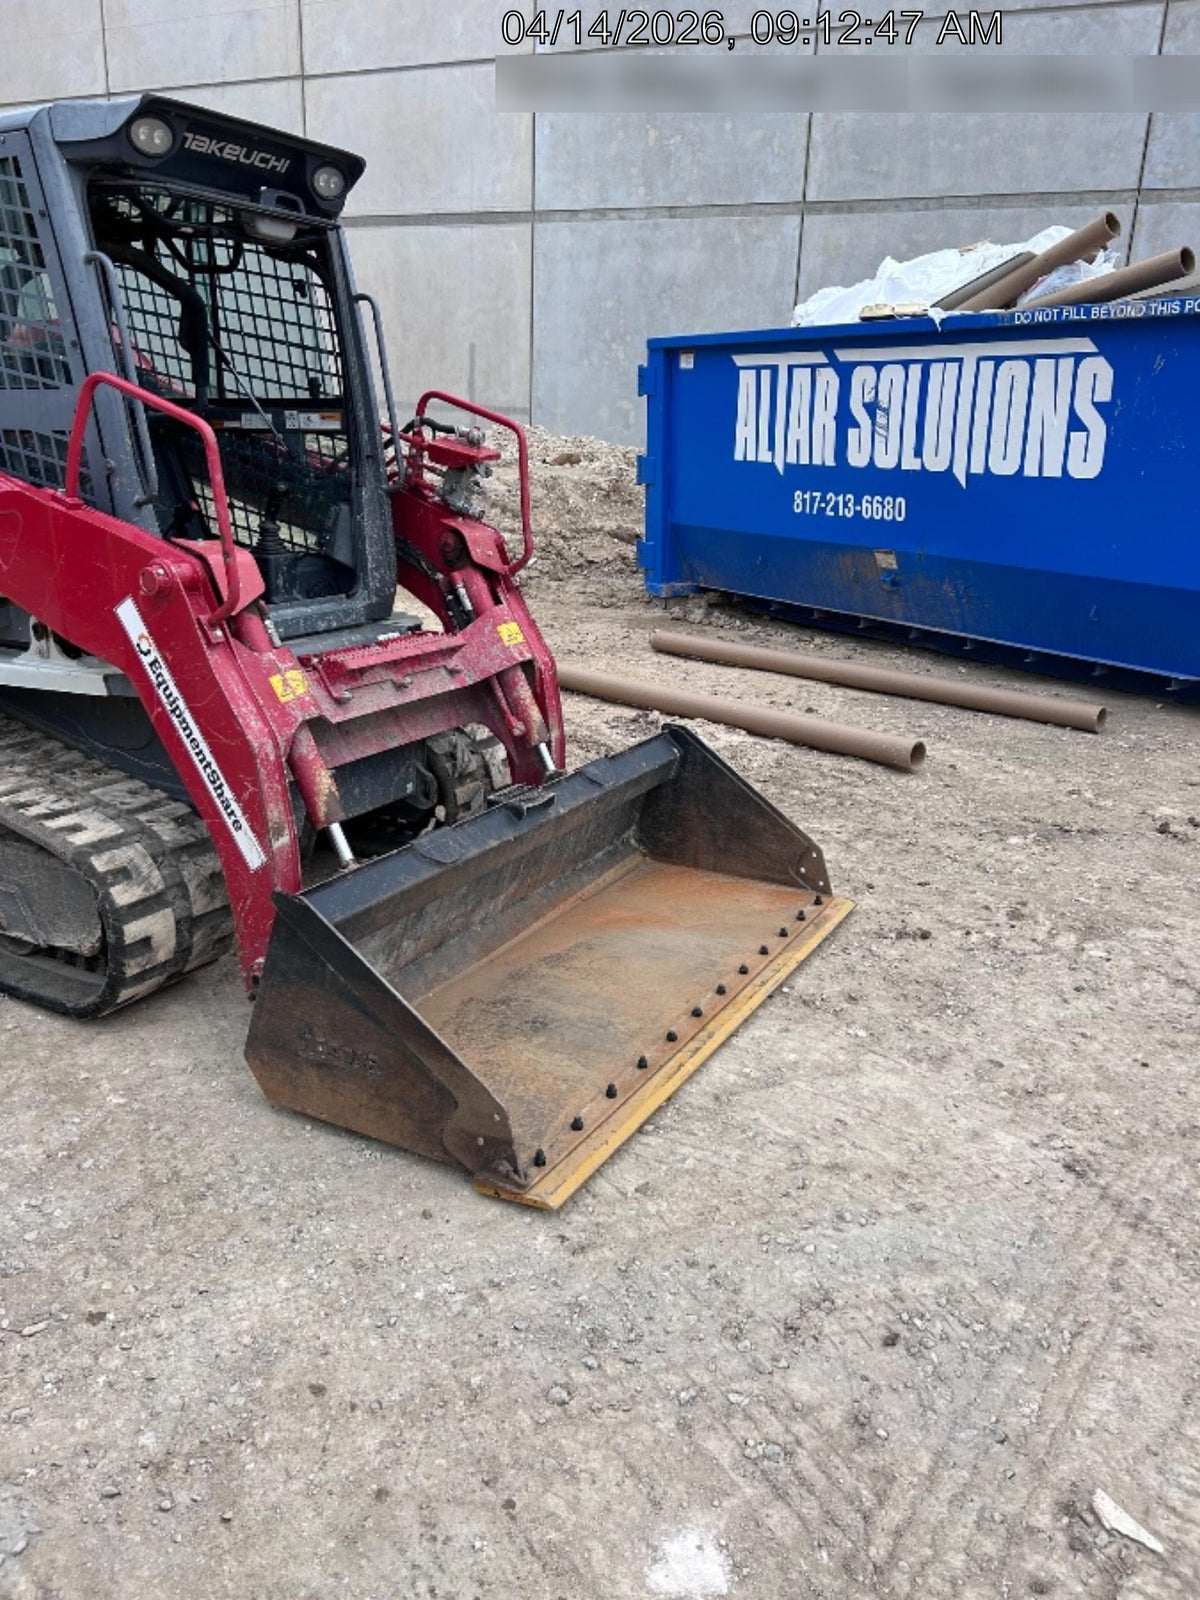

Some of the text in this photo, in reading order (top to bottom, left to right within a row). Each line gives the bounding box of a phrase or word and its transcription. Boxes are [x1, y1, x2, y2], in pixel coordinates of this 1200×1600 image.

[1014, 310, 1032, 324] DO
[1034, 309, 1060, 322] NOT
[1061, 307, 1087, 320] FILL
[1091, 304, 1146, 319] BEYOND
[1149, 301, 1180, 316] THIS
[731, 337, 1114, 489] ALTAR SOLUTIONS
[793, 490, 906, 522] 817-213-6680
[148, 656, 243, 832] EquipmentShare
